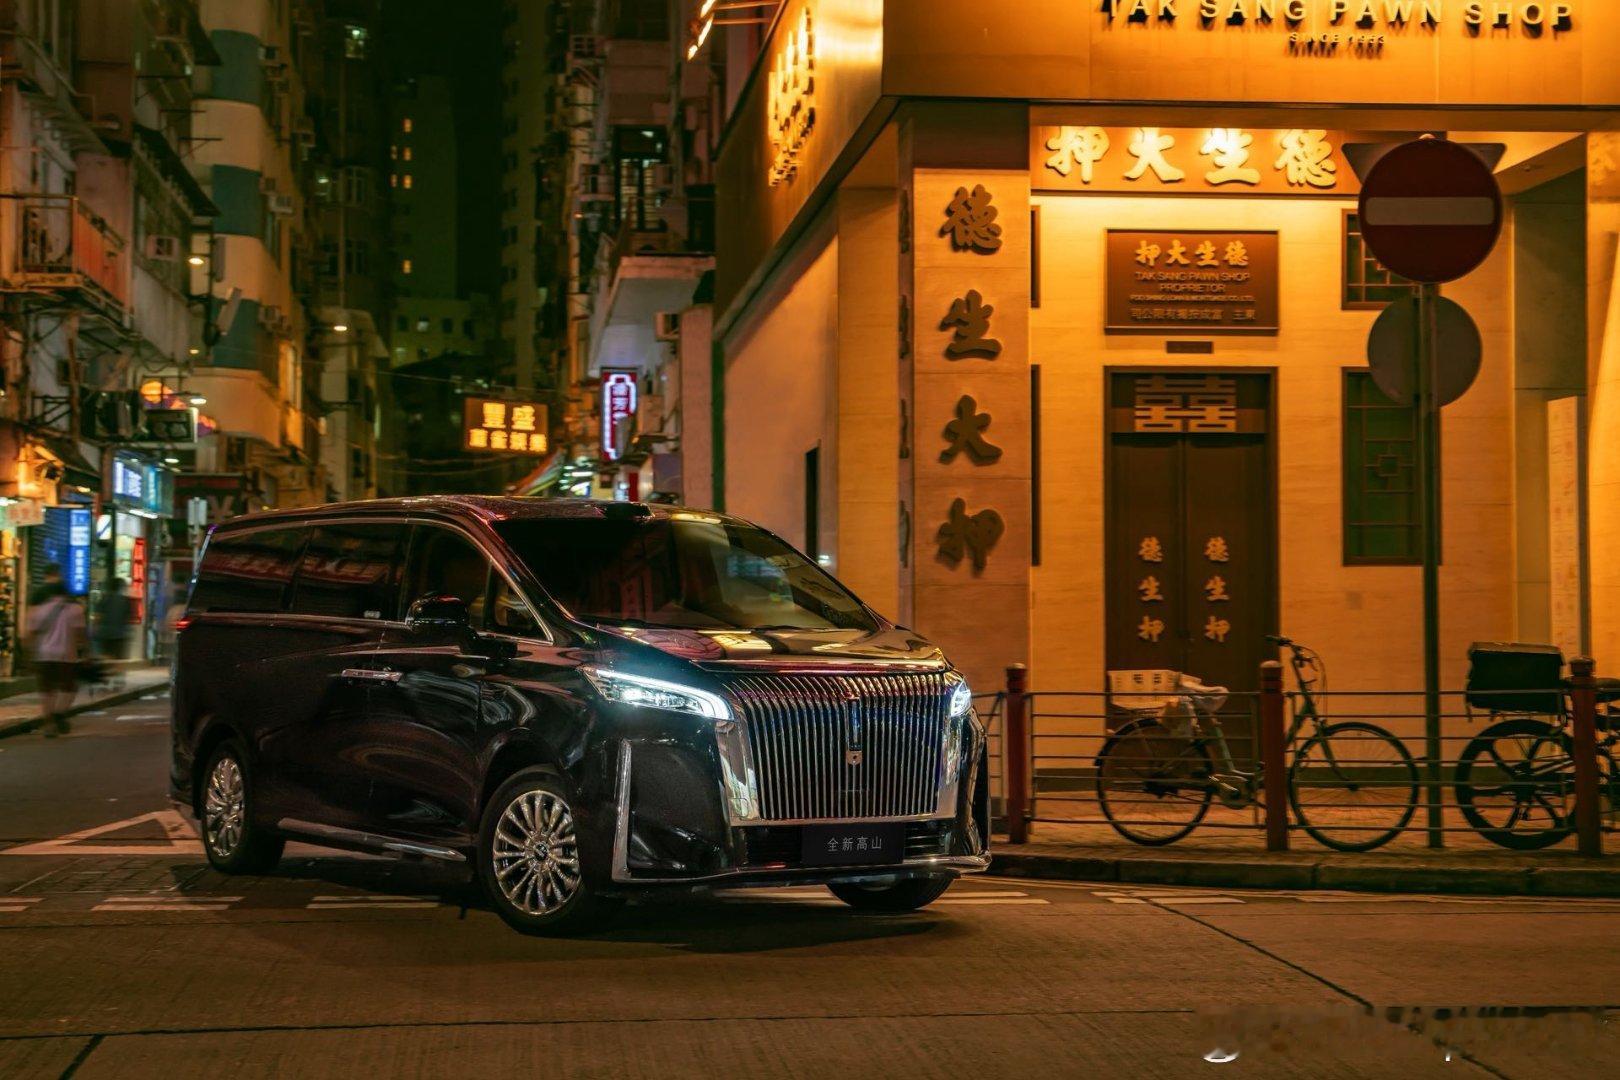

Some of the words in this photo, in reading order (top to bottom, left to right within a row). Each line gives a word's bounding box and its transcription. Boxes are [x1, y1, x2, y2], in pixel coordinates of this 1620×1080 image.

[1200, 0, 1307, 20] SANG
[1330, 0, 1441, 23] PAWN
[1465, 1, 1572, 26] SHOP
[1289, 32, 1340, 43] SINCE
[1135, 272, 1157, 281] TAK
[1158, 272, 1187, 281] SANG
[1189, 272, 1219, 281] PAWN
[1221, 272, 1250, 281] SHOP
[1160, 283, 1227, 293] PROPRIETOR
[937, 183, 1004, 577] 德生大押
[827, 836, 882, 851] 全新高山
